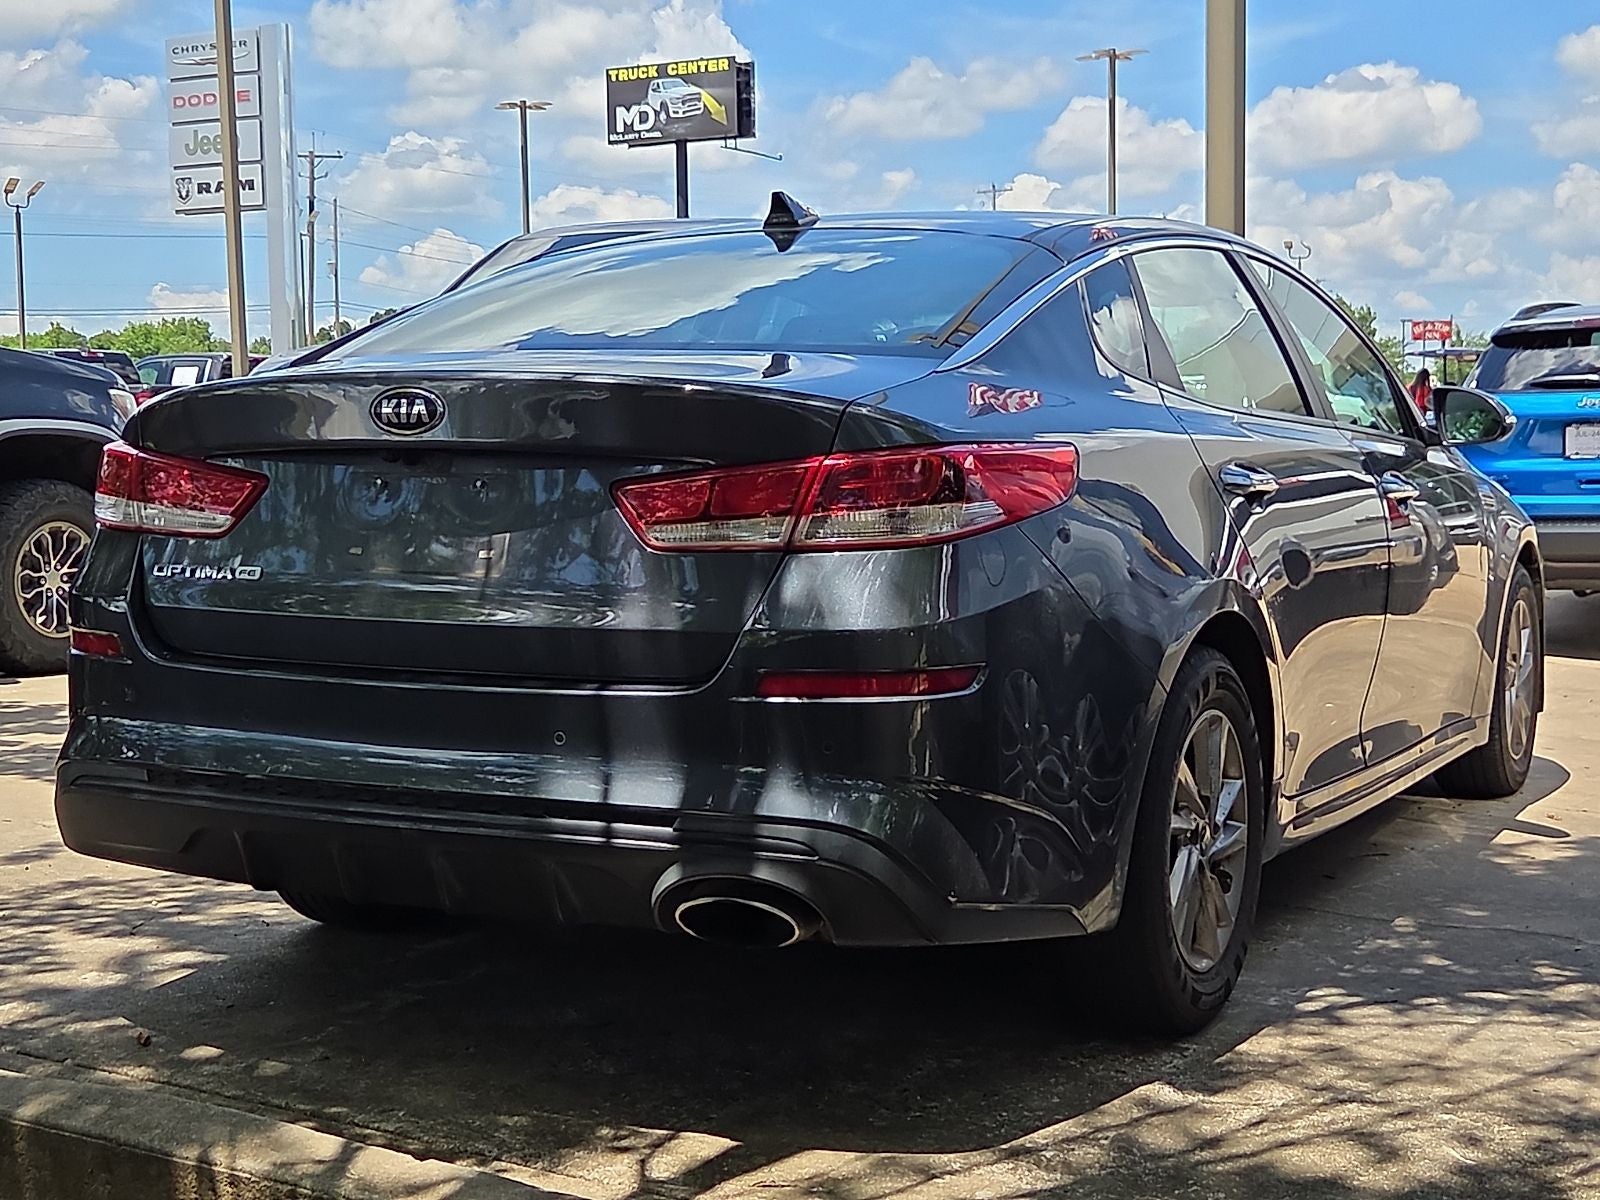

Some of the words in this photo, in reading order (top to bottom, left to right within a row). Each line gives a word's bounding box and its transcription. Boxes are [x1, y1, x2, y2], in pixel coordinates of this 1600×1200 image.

[171, 40, 248, 55] CHRYSER
[608, 66, 658, 82] TRUCK
[667, 58, 729, 76] CENTER
[173, 90, 251, 109] DODE
[615, 105, 656, 132] MD
[185, 129, 240, 156] Jee
[197, 179, 255, 195] RAM
[381, 398, 430, 423] KIA
[1577, 396, 1600, 407] Jee
[152, 564, 233, 579] OPTIMA
